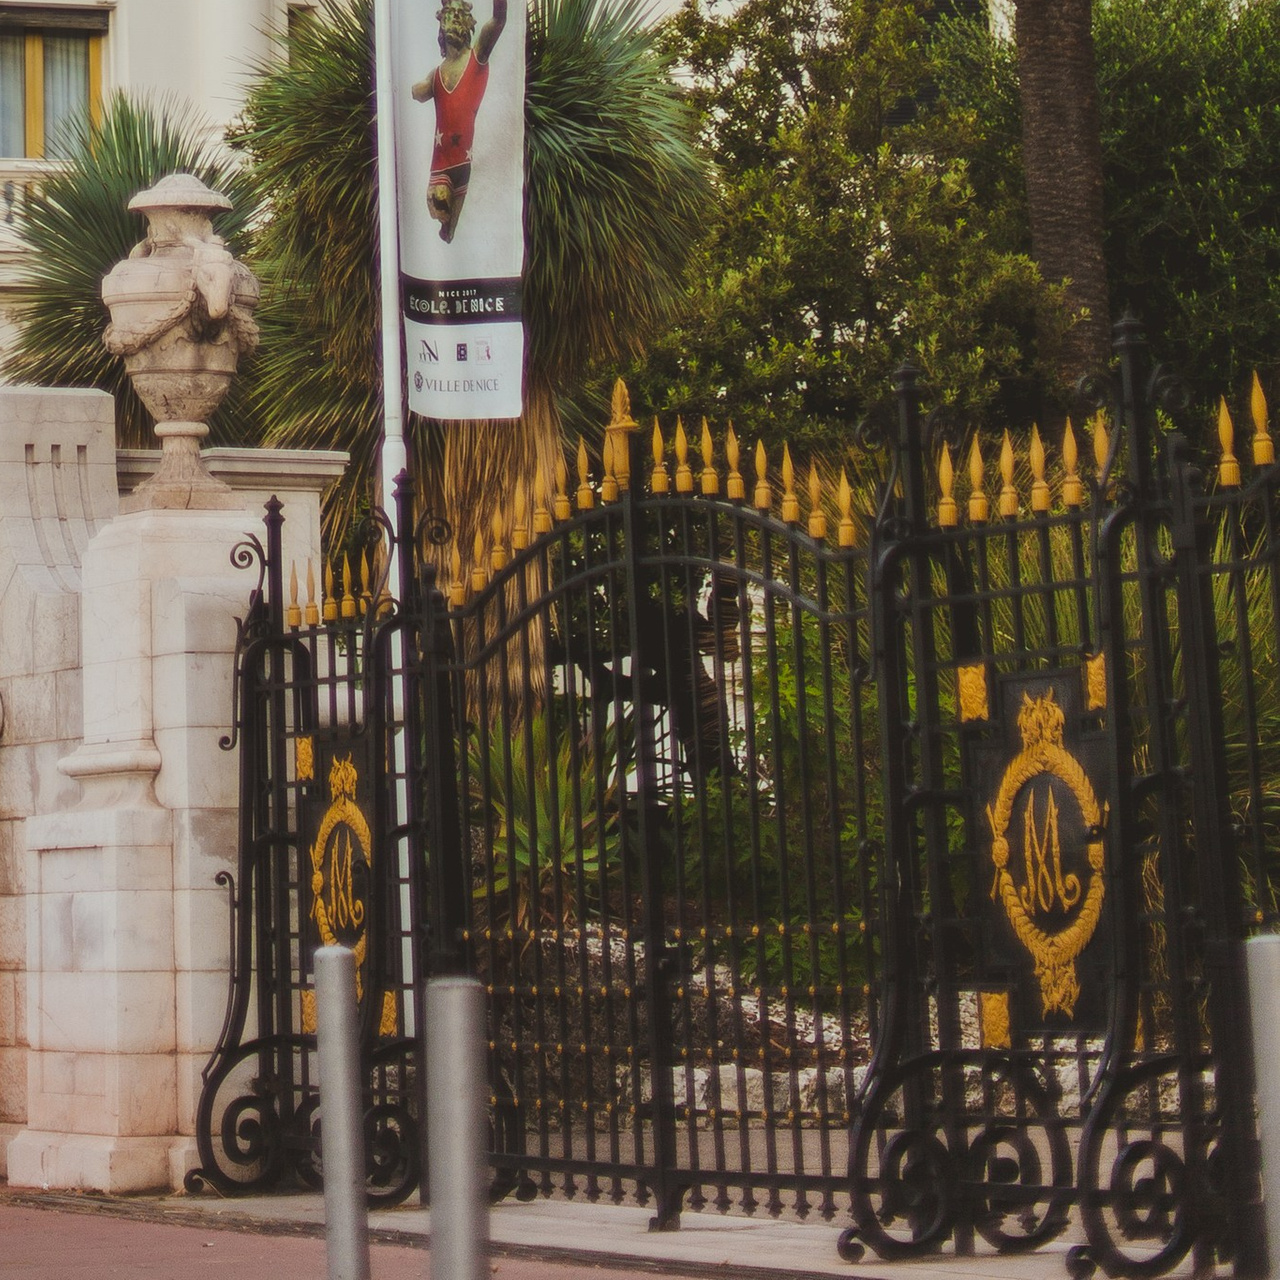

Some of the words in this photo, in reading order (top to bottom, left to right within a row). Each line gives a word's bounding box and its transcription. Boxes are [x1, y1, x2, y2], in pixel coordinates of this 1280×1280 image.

[438, 290, 460, 298] NICE
[462, 289, 477, 297] 2017
[470, 297, 505, 313] NICE
[425, 378, 460, 393] VILLE
[463, 379, 475, 392] DE
[476, 378, 500, 392] NICE
